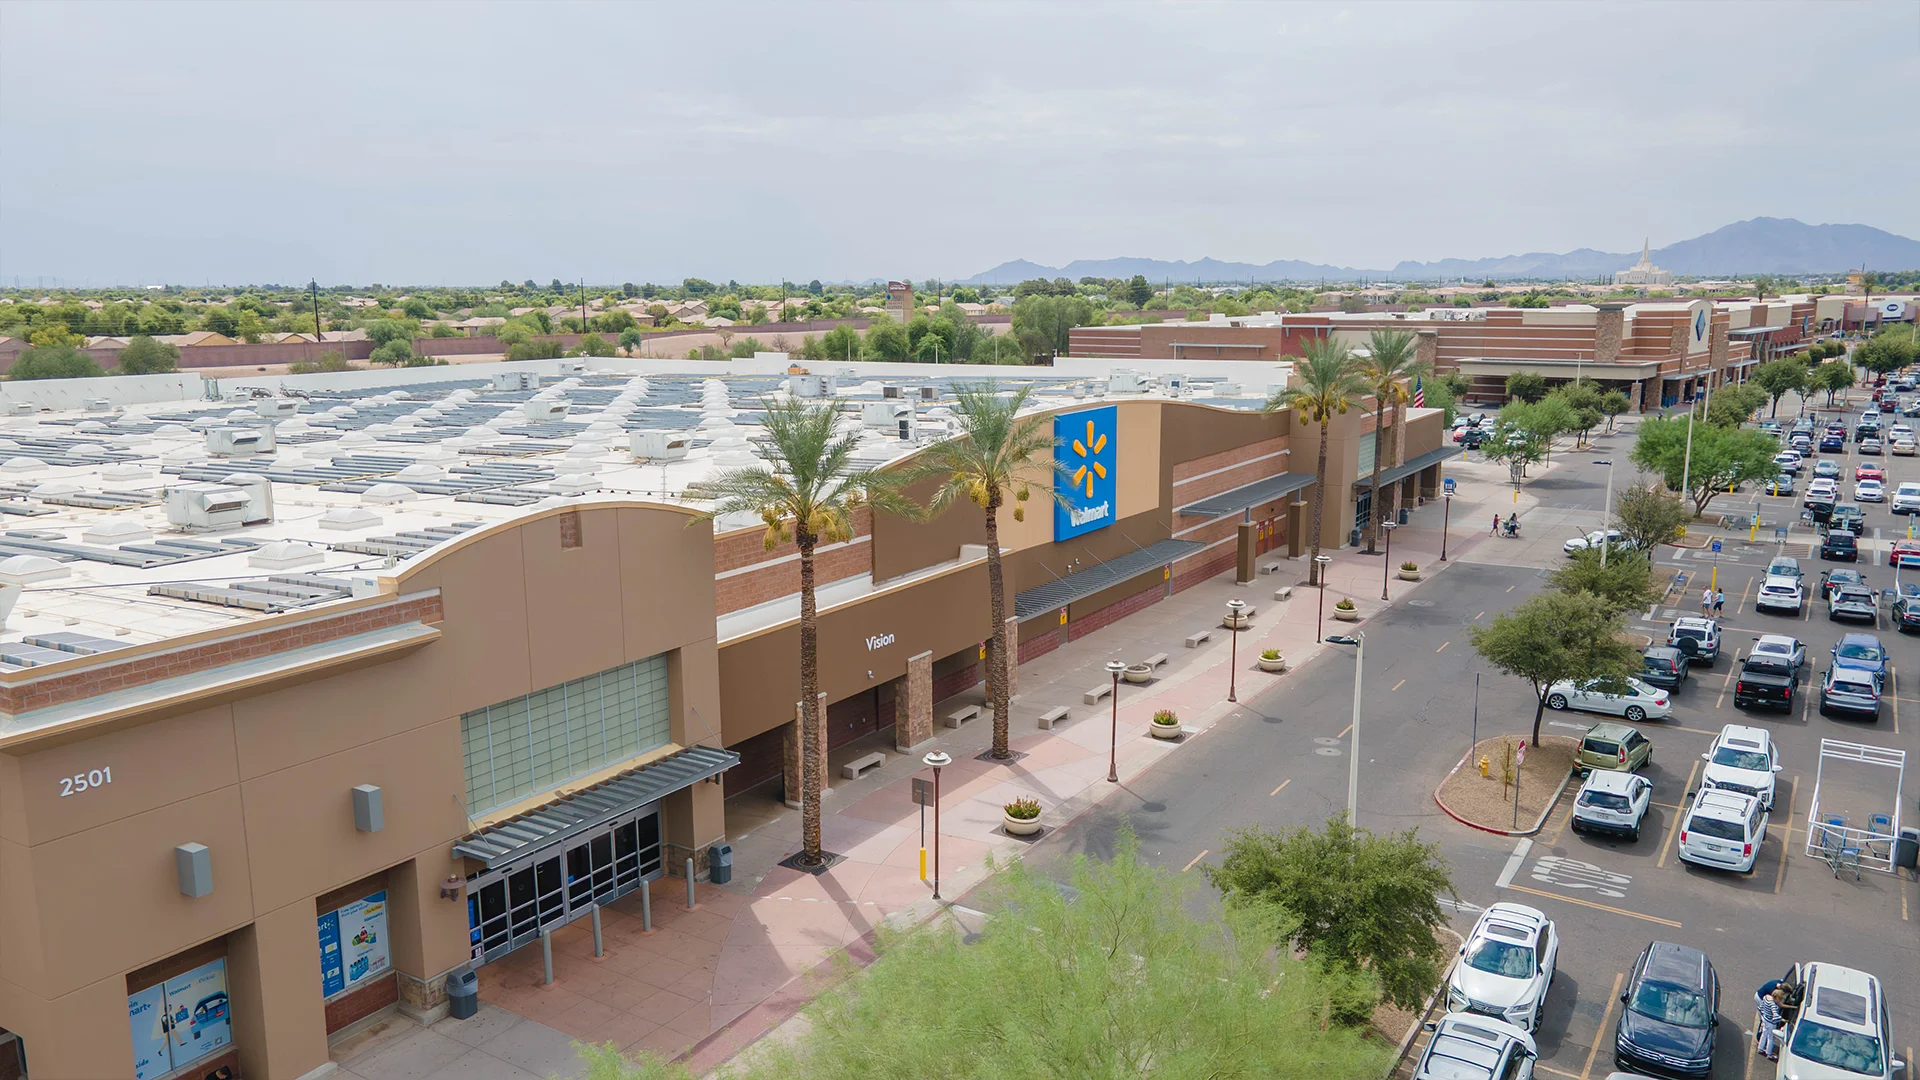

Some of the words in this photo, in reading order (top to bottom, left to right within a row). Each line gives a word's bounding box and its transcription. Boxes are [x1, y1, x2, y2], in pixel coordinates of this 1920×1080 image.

[1071, 500, 1109, 527] Walmart
[865, 633, 895, 652] Vision
[59, 766, 112, 797] 2501
[1530, 855, 1633, 898] STOP
[169, 984, 191, 996] Walmart
